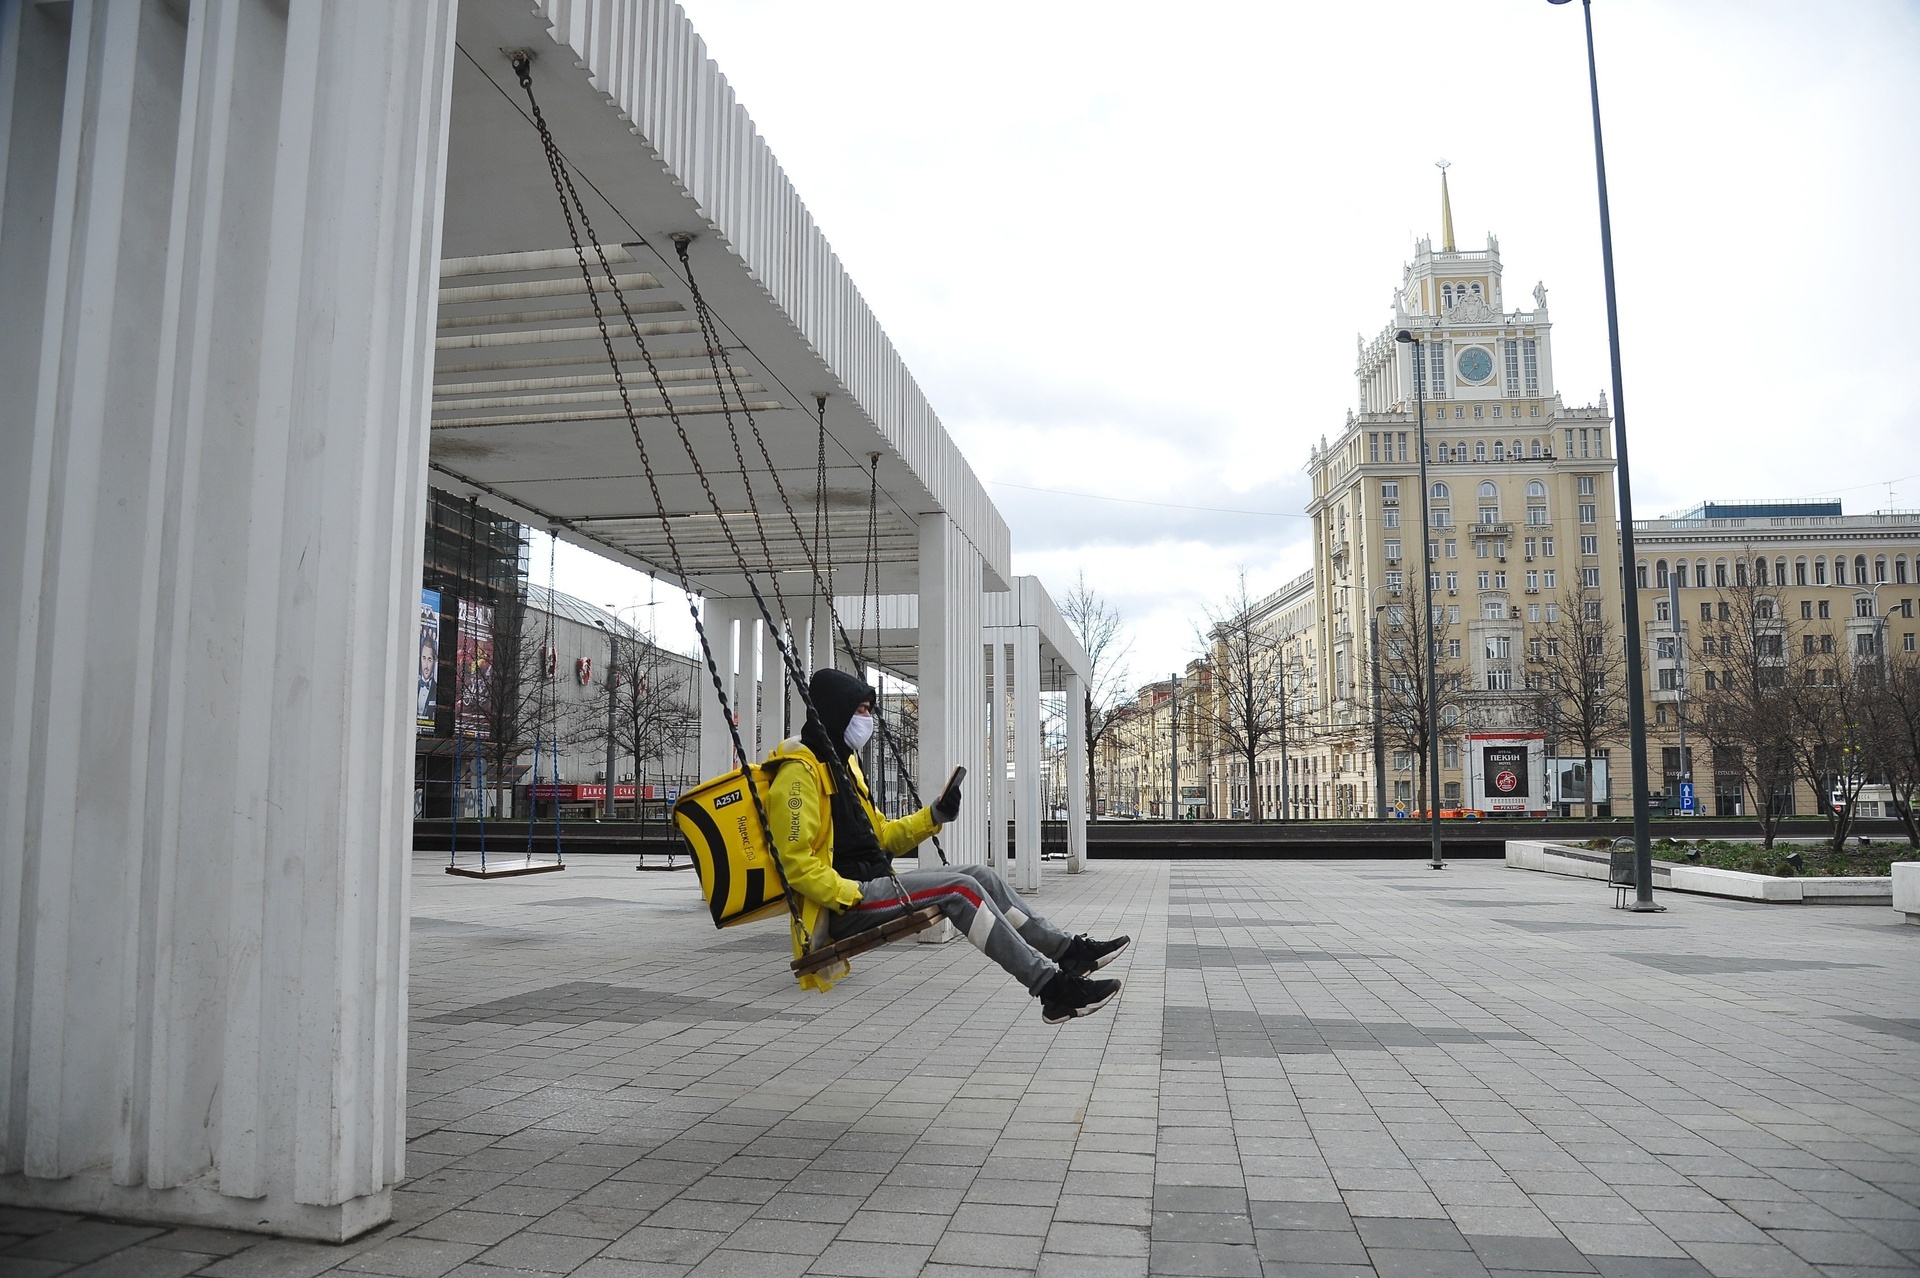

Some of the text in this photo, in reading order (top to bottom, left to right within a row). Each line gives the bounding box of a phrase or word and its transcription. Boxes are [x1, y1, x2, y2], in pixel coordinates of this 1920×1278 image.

[582, 787, 615, 796] ДАМСК
[619, 787, 647, 795] СЧАСЬ
[716, 791, 740, 807] A2517
[788, 781, 801, 842] Яндекс Еда
[1683, 798, 1692, 809] P
[737, 815, 756, 861] Яндекс Еда
